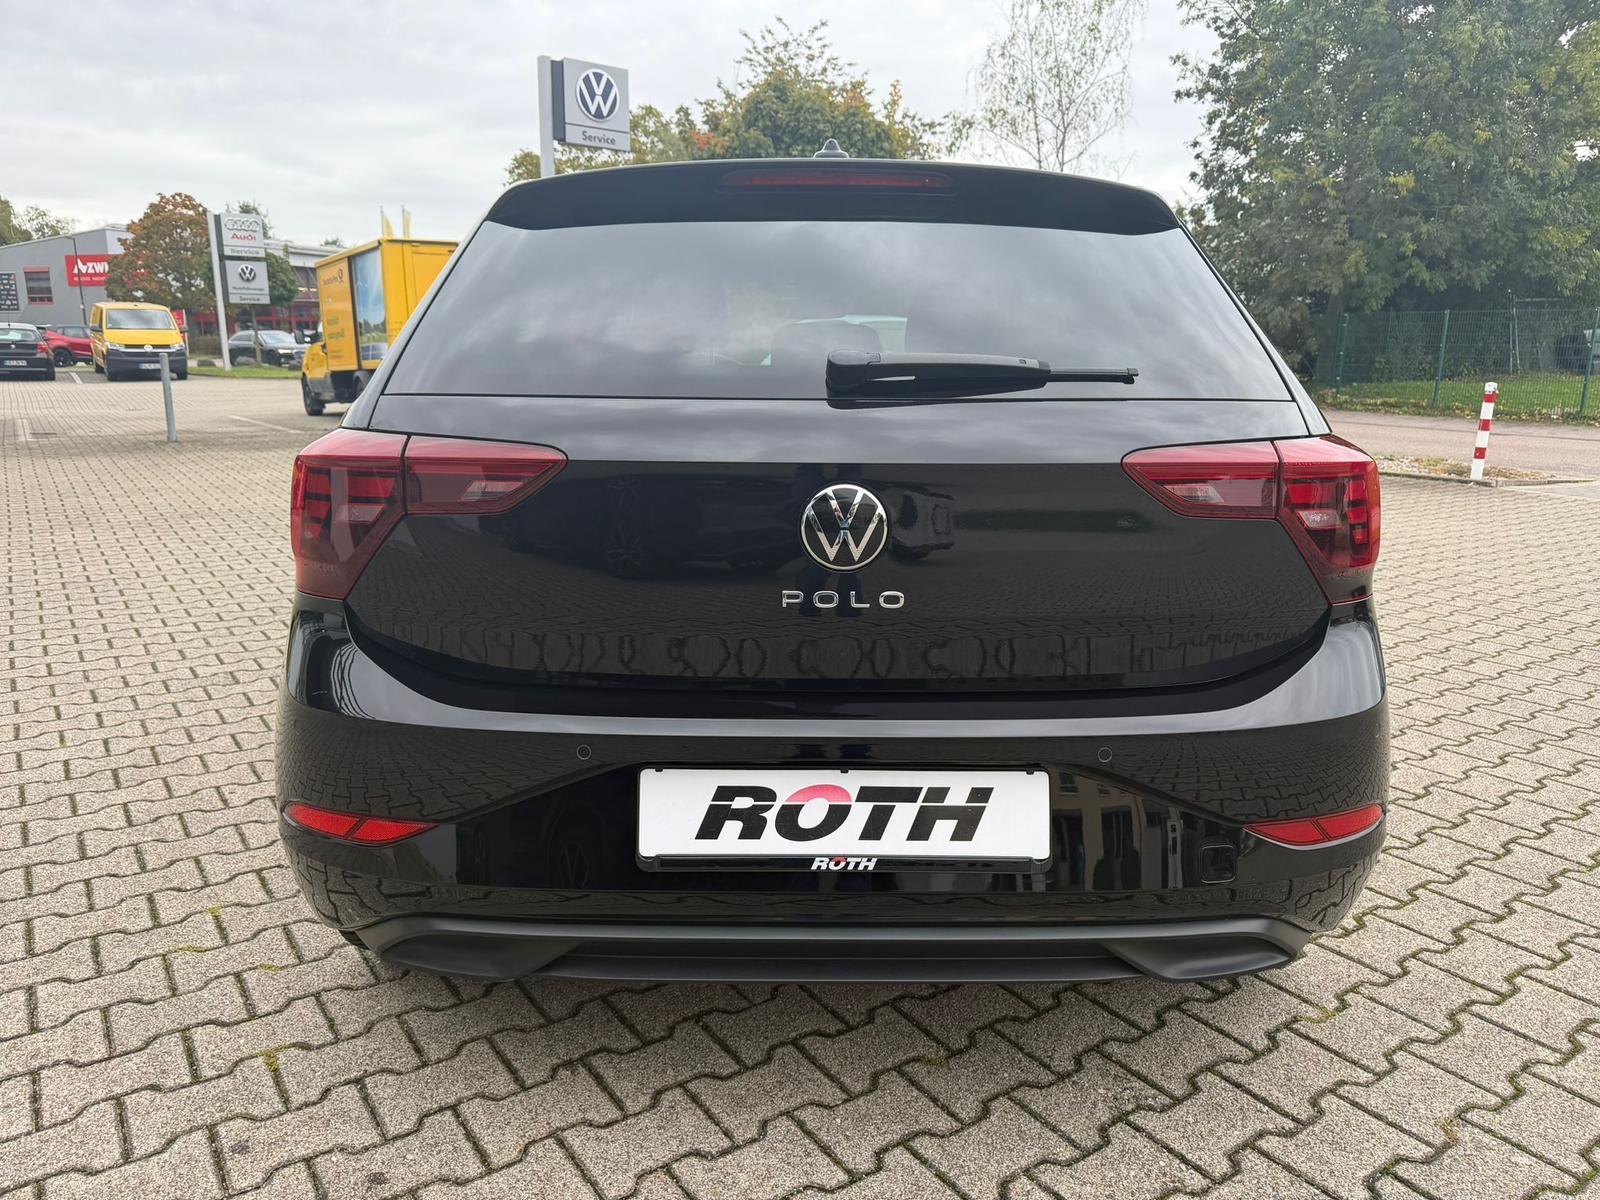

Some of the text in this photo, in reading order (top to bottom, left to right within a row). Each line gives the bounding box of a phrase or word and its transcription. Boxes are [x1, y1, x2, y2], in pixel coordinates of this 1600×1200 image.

[582, 130, 616, 145] Service
[231, 233, 257, 241] Audi
[781, 590, 905, 609] POLO
[694, 784, 995, 842] ROTH
[810, 857, 878, 871] ROTH
